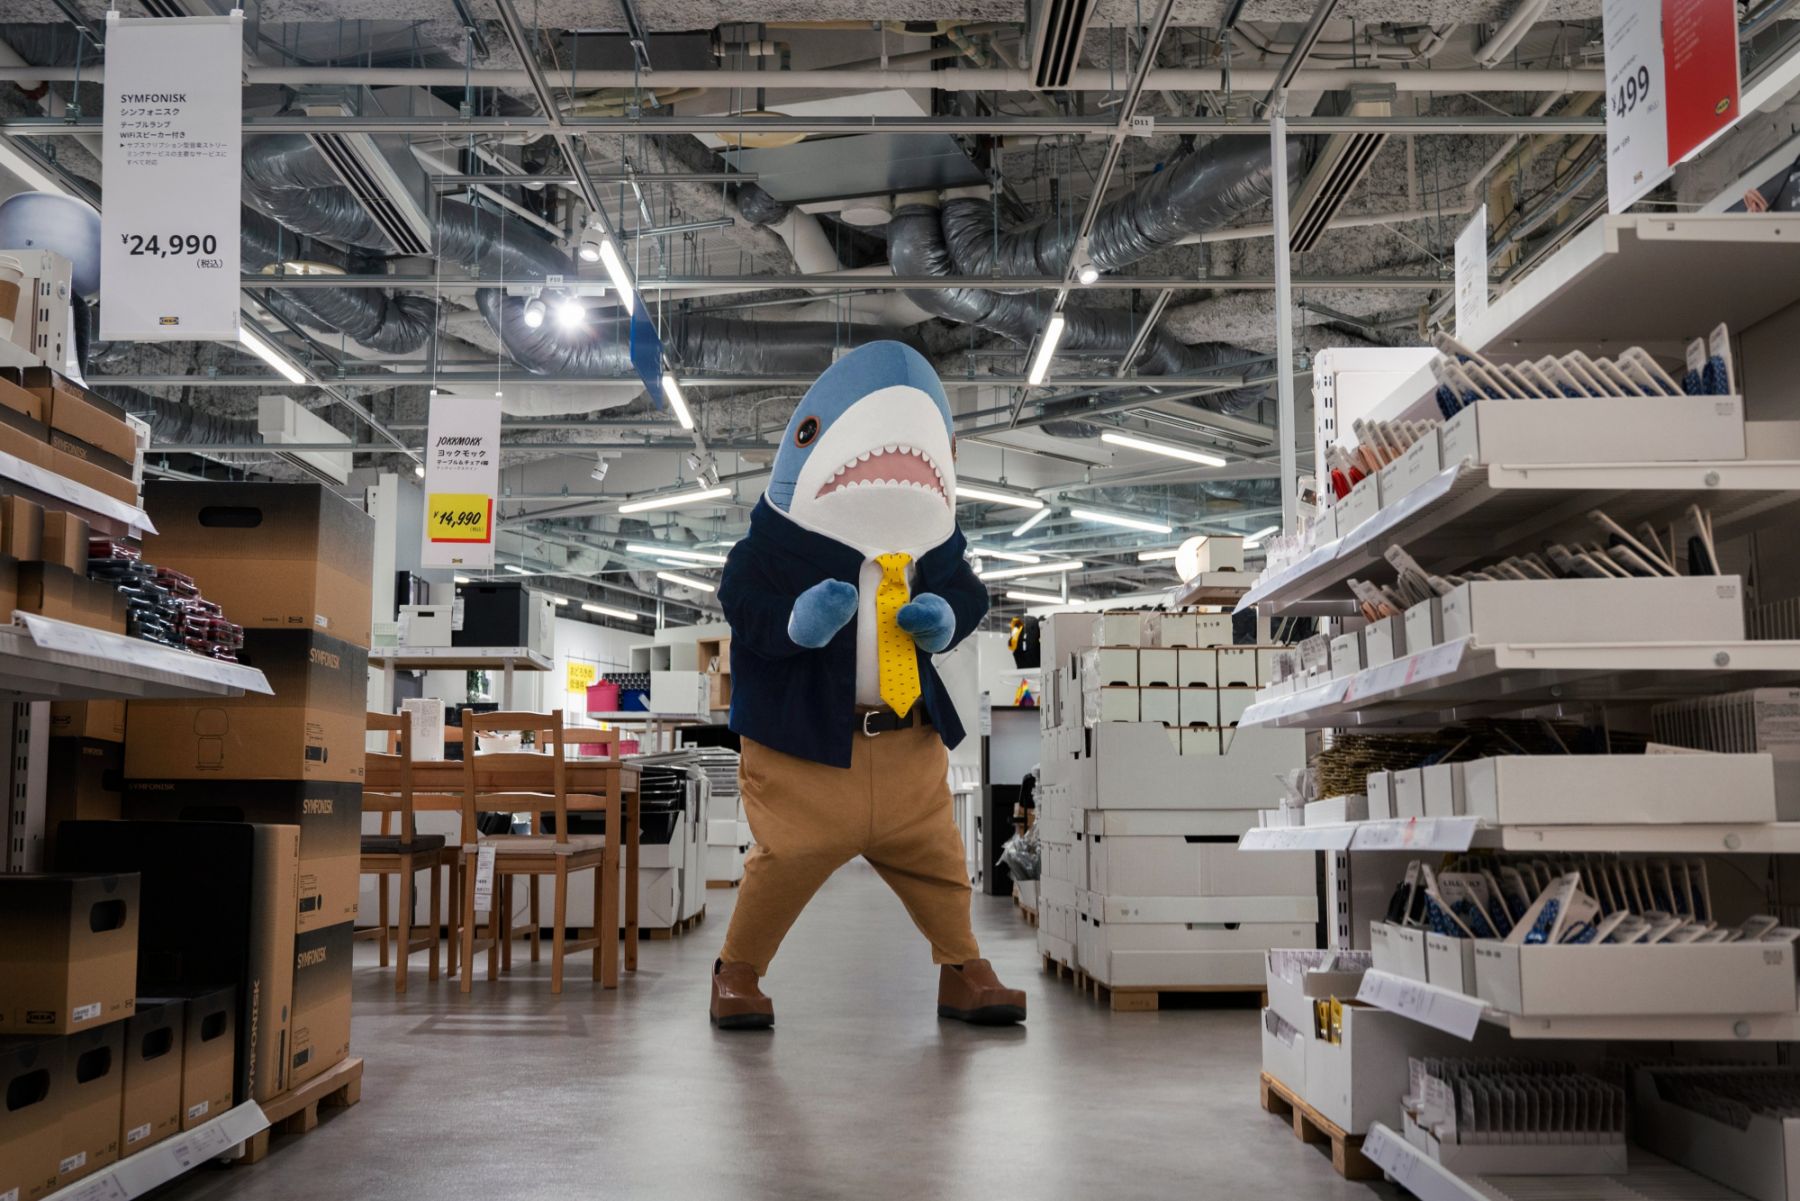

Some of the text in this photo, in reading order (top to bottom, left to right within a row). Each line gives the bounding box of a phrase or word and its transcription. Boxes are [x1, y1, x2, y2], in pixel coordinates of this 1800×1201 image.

[120, 93, 187, 103] SYMFONISK
[1611, 65, 1650, 118] ¥499
[120, 108, 181, 116] シンフォニスク
[120, 120, 171, 128] テーブルランプ
[121, 234, 217, 259] ¥24,990
[435, 436, 483, 448] JOKKMOKK
[437, 449, 487, 458] ヨックモック
[433, 510, 482, 528] ¥14,990
[309, 647, 341, 670] SYMFONISK
[302, 799, 334, 815] SYMFONISK
[297, 946, 327, 969] SYMFONISK
